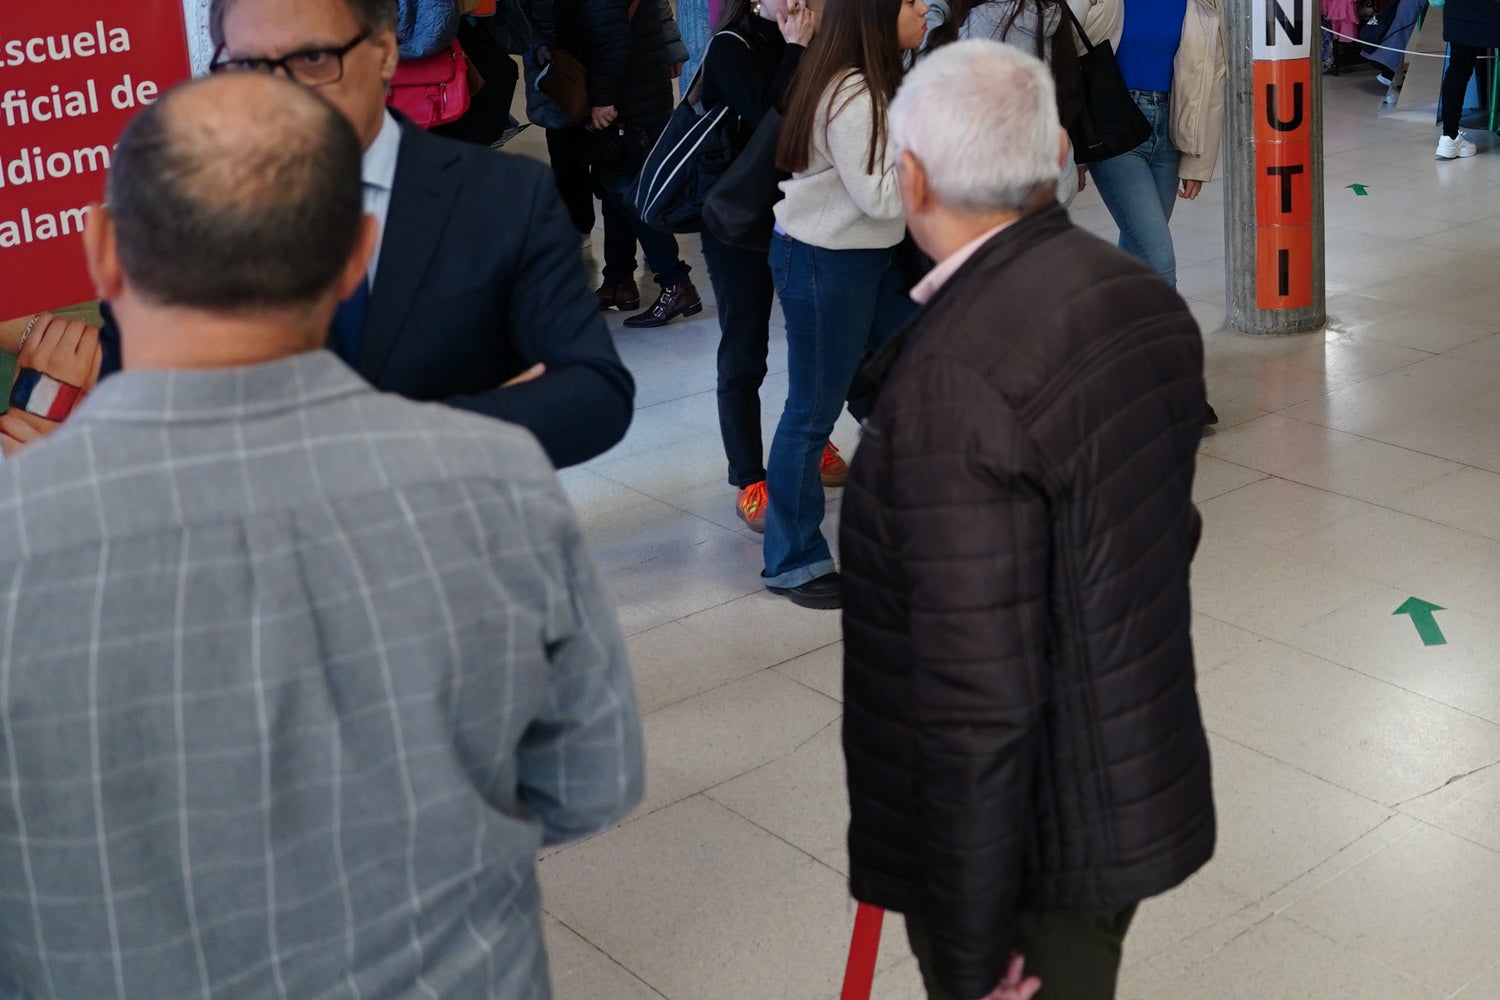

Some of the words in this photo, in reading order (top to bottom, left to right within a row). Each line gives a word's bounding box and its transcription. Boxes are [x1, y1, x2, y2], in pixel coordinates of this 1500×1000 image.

[0, 79, 99, 126] ficial
[111, 74, 159, 110] de
[0, 143, 120, 188] Idiom
[0, 203, 108, 248] alam
